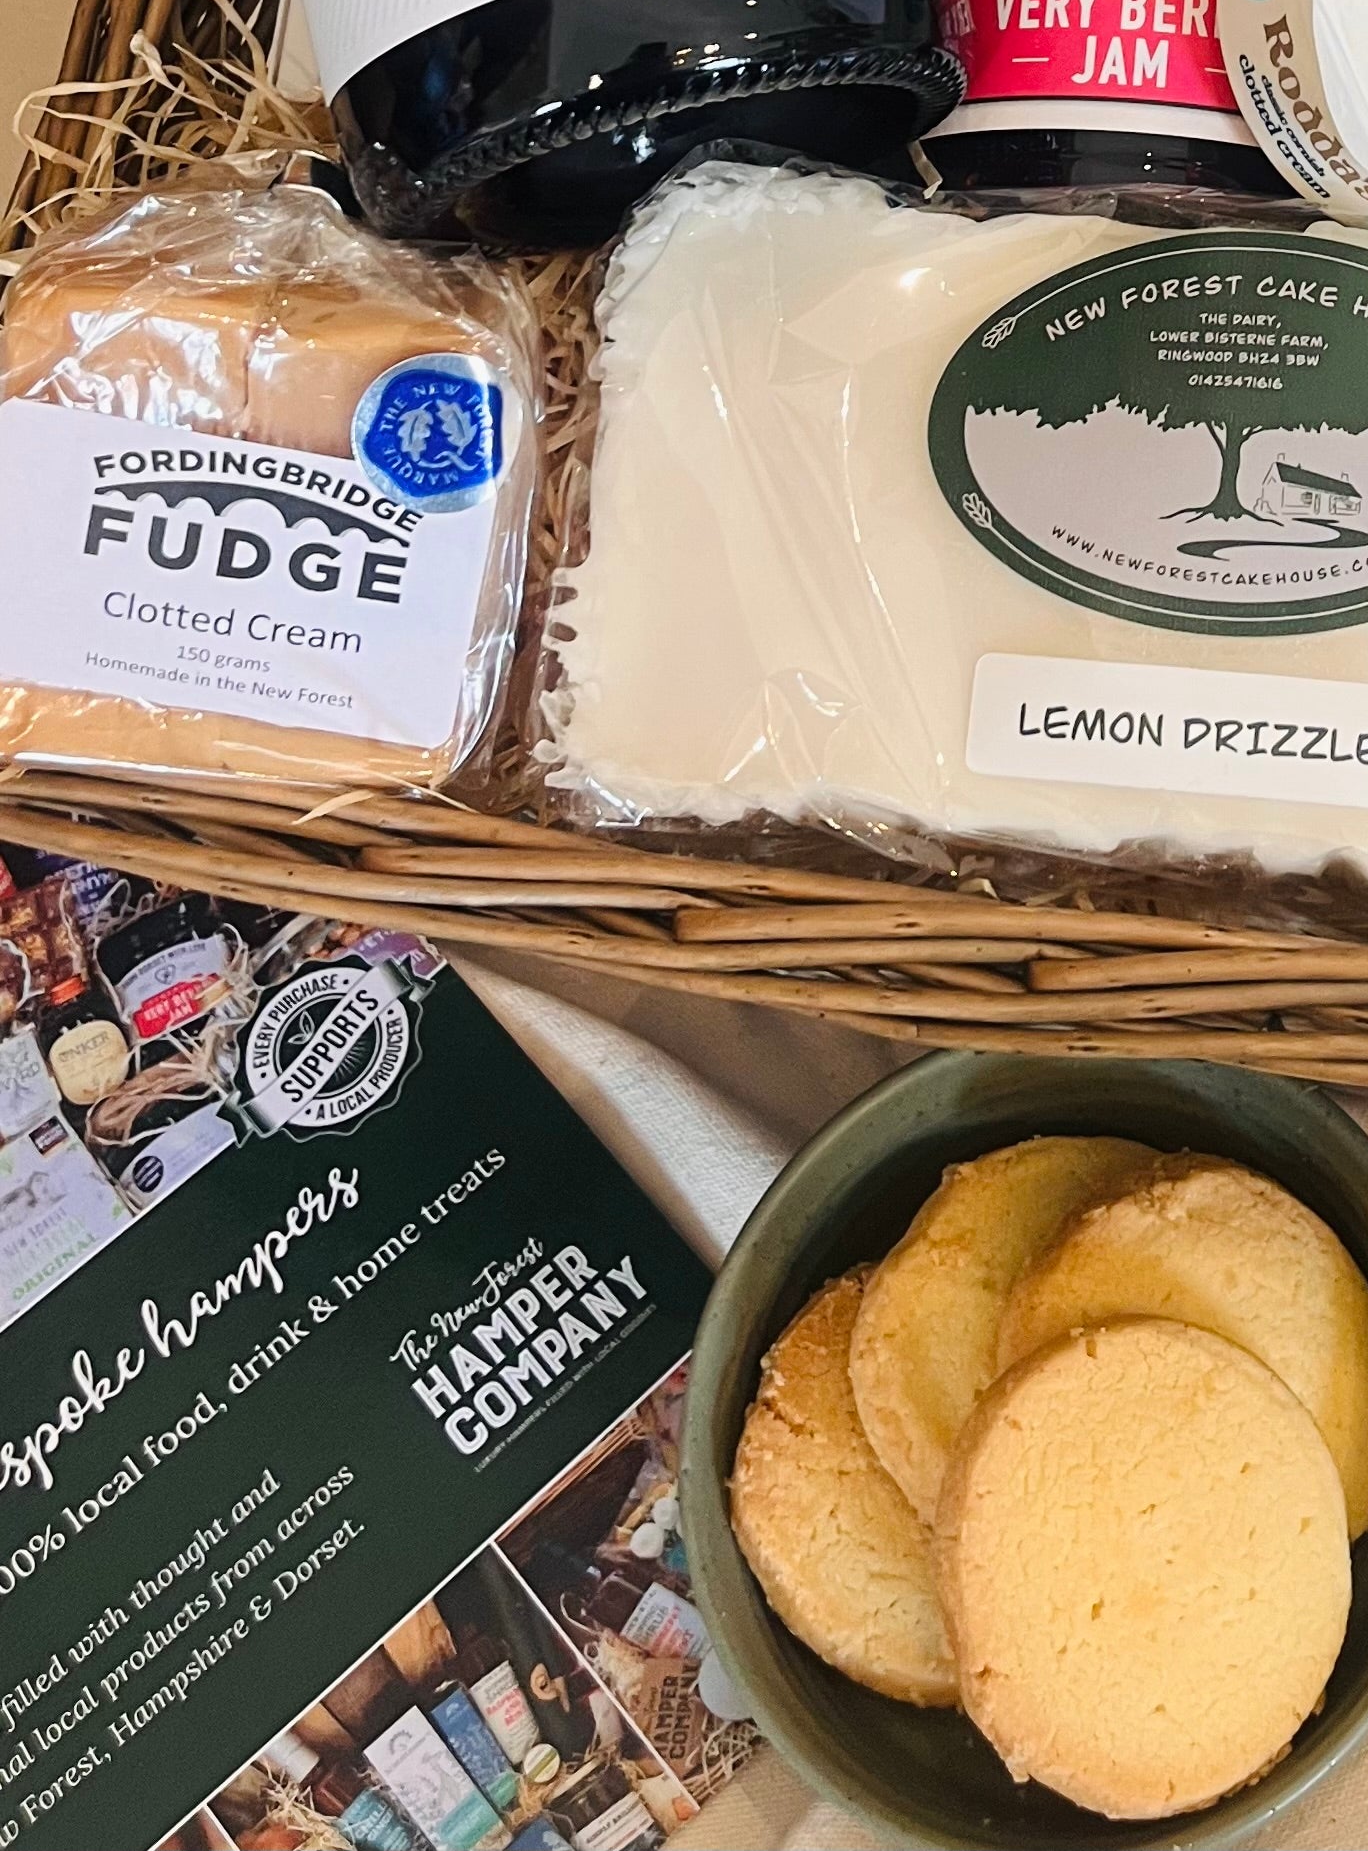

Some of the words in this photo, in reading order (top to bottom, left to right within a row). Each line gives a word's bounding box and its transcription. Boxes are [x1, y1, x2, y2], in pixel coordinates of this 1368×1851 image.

[1071, 36, 1169, 88] JAM
[1045, 297, 1106, 342] NEW
[1121, 275, 1243, 309] FOREST
[1257, 276, 1338, 308] CAKE
[1150, 330, 1199, 344] LOWER
[1205, 333, 1276, 346] BISTERNE
[1281, 334, 1329, 351] FARM,
[1199, 313, 1228, 325] THE
[1233, 313, 1282, 329] DAIRY,
[1158, 350, 1233, 363] RINGWOOD
[1239, 352, 1280, 365] BH24
[1286, 354, 1320, 366] 3BW
[1188, 375, 1283, 390] 01425471616
[93, 449, 424, 532] FORDINGBRIDGE
[83, 505, 408, 604] FUDGE
[103, 592, 235, 637] Clotted
[247, 614, 362, 653] Cream
[84, 651, 189, 685] Homemade
[193, 672, 211, 688] in
[216, 674, 246, 693] the
[251, 680, 292, 702] New
[297, 687, 353, 710] Forest
[176, 645, 208, 663] 150
[214, 650, 271, 674] grams
[1019, 702, 1164, 749] LEMON
[281, 989, 378, 1104] SUPPORTS
[140, 1166, 360, 1358] hampers
[411, 1245, 598, 1419] HAMPER
[444, 1255, 647, 1455] COMPANY
[0, 1654, 69, 1732] filled
[68, 1606, 130, 1665] with
[128, 1517, 229, 1610] thought
[232, 1466, 281, 1525] and
[32, 1685, 100, 1751] local
[100, 1591, 211, 1702] products
[208, 1536, 276, 1608] from
[277, 1465, 355, 1541] across
[19, 1744, 112, 1825] Forest,
[107, 1617, 250, 1747] Hampshire
[249, 1594, 273, 1622] &
[271, 1518, 366, 1601] Dorset.
